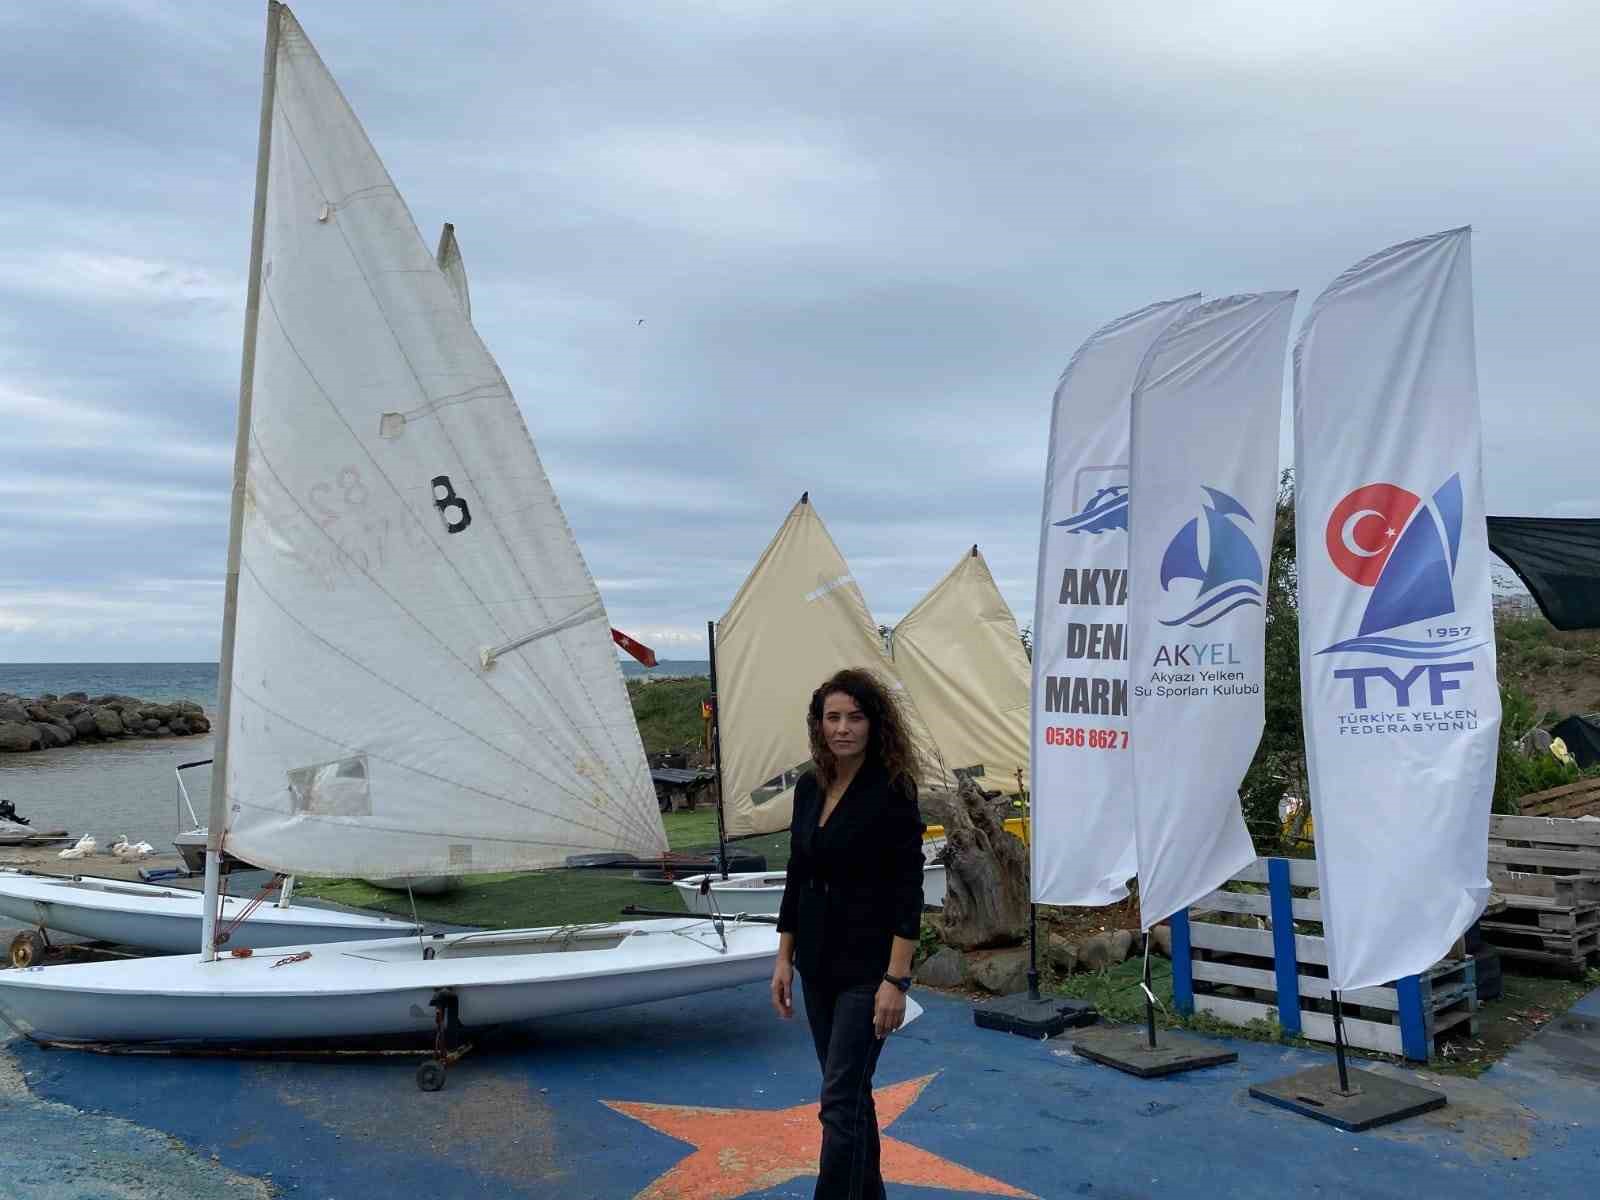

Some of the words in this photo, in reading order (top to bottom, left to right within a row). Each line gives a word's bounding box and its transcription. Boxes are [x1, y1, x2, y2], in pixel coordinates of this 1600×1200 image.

[1426, 626, 1472, 639] 1957
[1153, 643, 1241, 667] AKYEL
[1151, 671, 1195, 684] Akyazı
[1199, 670, 1244, 682] Yelken
[1134, 686, 1152, 697] Su
[1156, 686, 1208, 698] Sporları
[1213, 683, 1259, 696] Kulubü
[1334, 661, 1474, 710] TYF
[1338, 711, 1405, 725] TÜRKİYE
[1411, 709, 1477, 721] YELKEN
[1339, 720, 1478, 736] FEDERASYONU
[1045, 726, 1085, 748] 0536
[1088, 728, 1117, 750] 862
